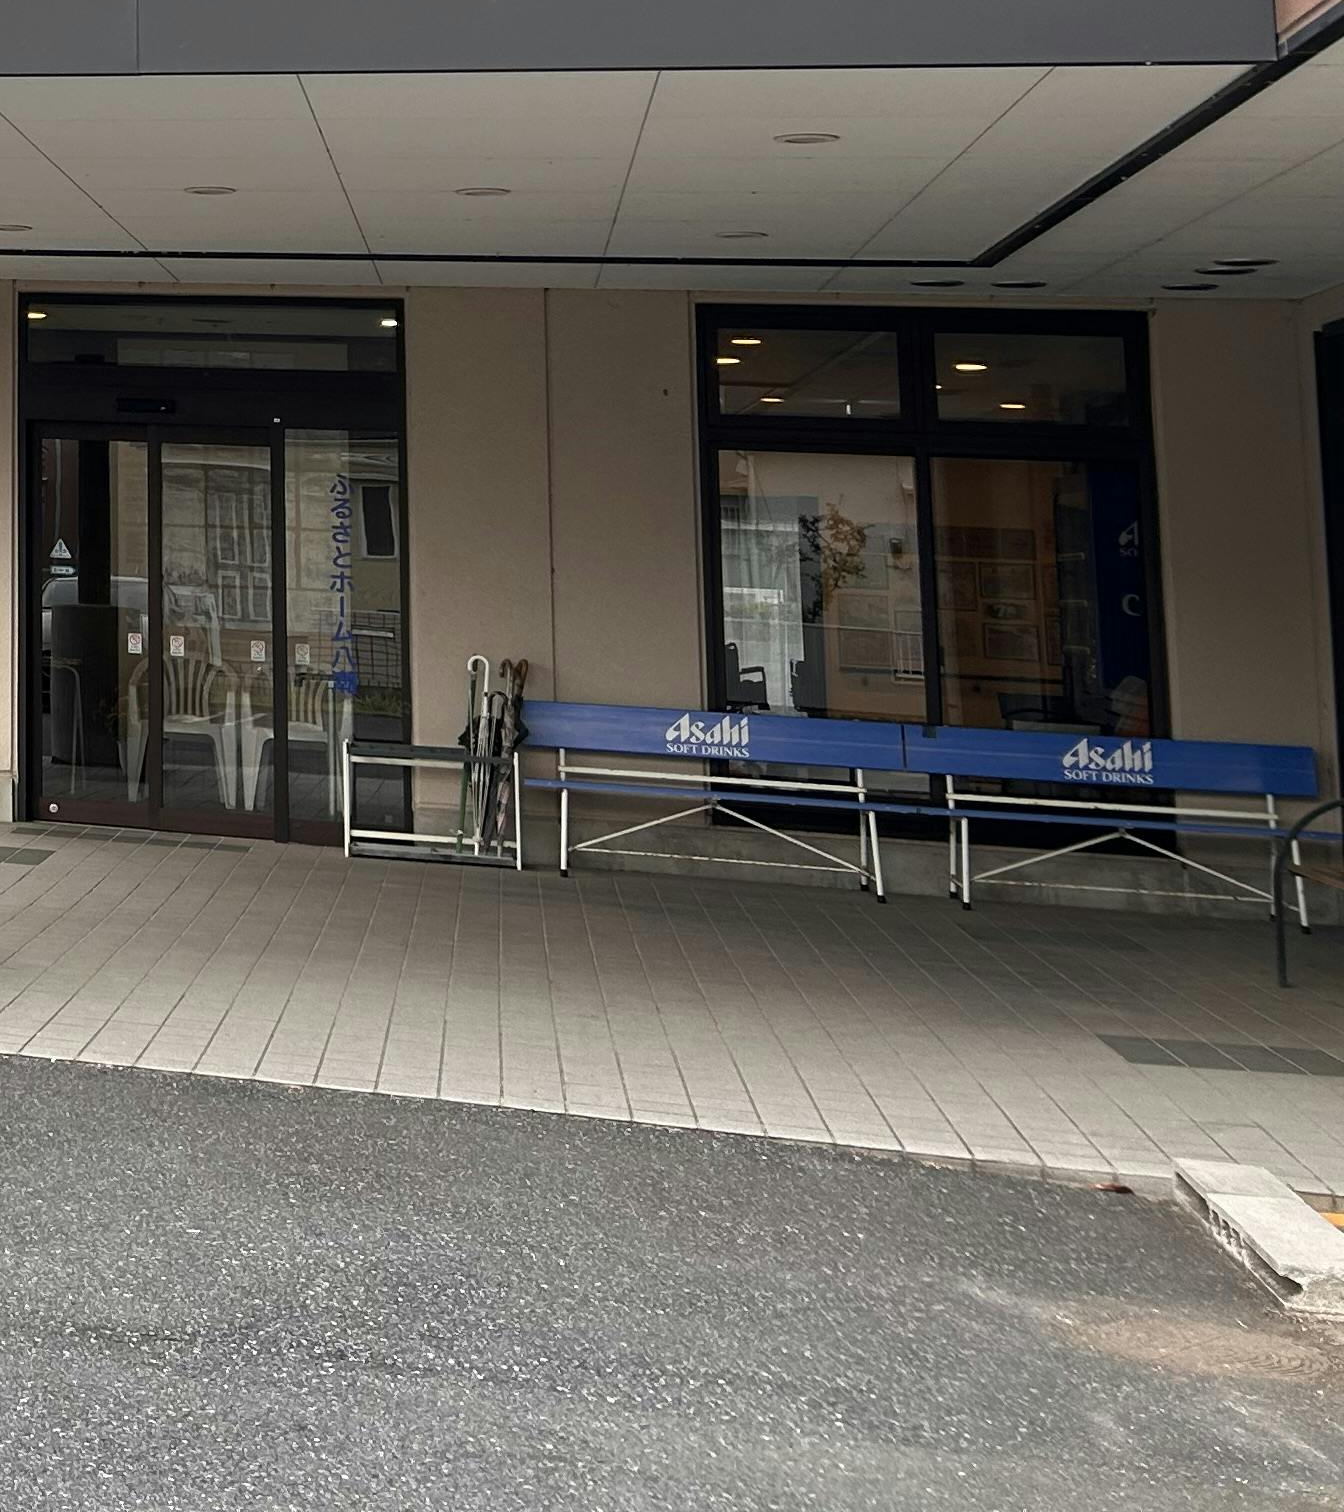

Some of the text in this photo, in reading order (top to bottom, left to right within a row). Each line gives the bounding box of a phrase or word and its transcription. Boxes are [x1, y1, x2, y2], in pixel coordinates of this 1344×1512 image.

[665, 712, 750, 746] Asahi
[666, 743, 750, 758] SOFT DRINKS
[1062, 738, 1153, 772] Asahi
[1064, 769, 1154, 785] SOFT DRINKS
